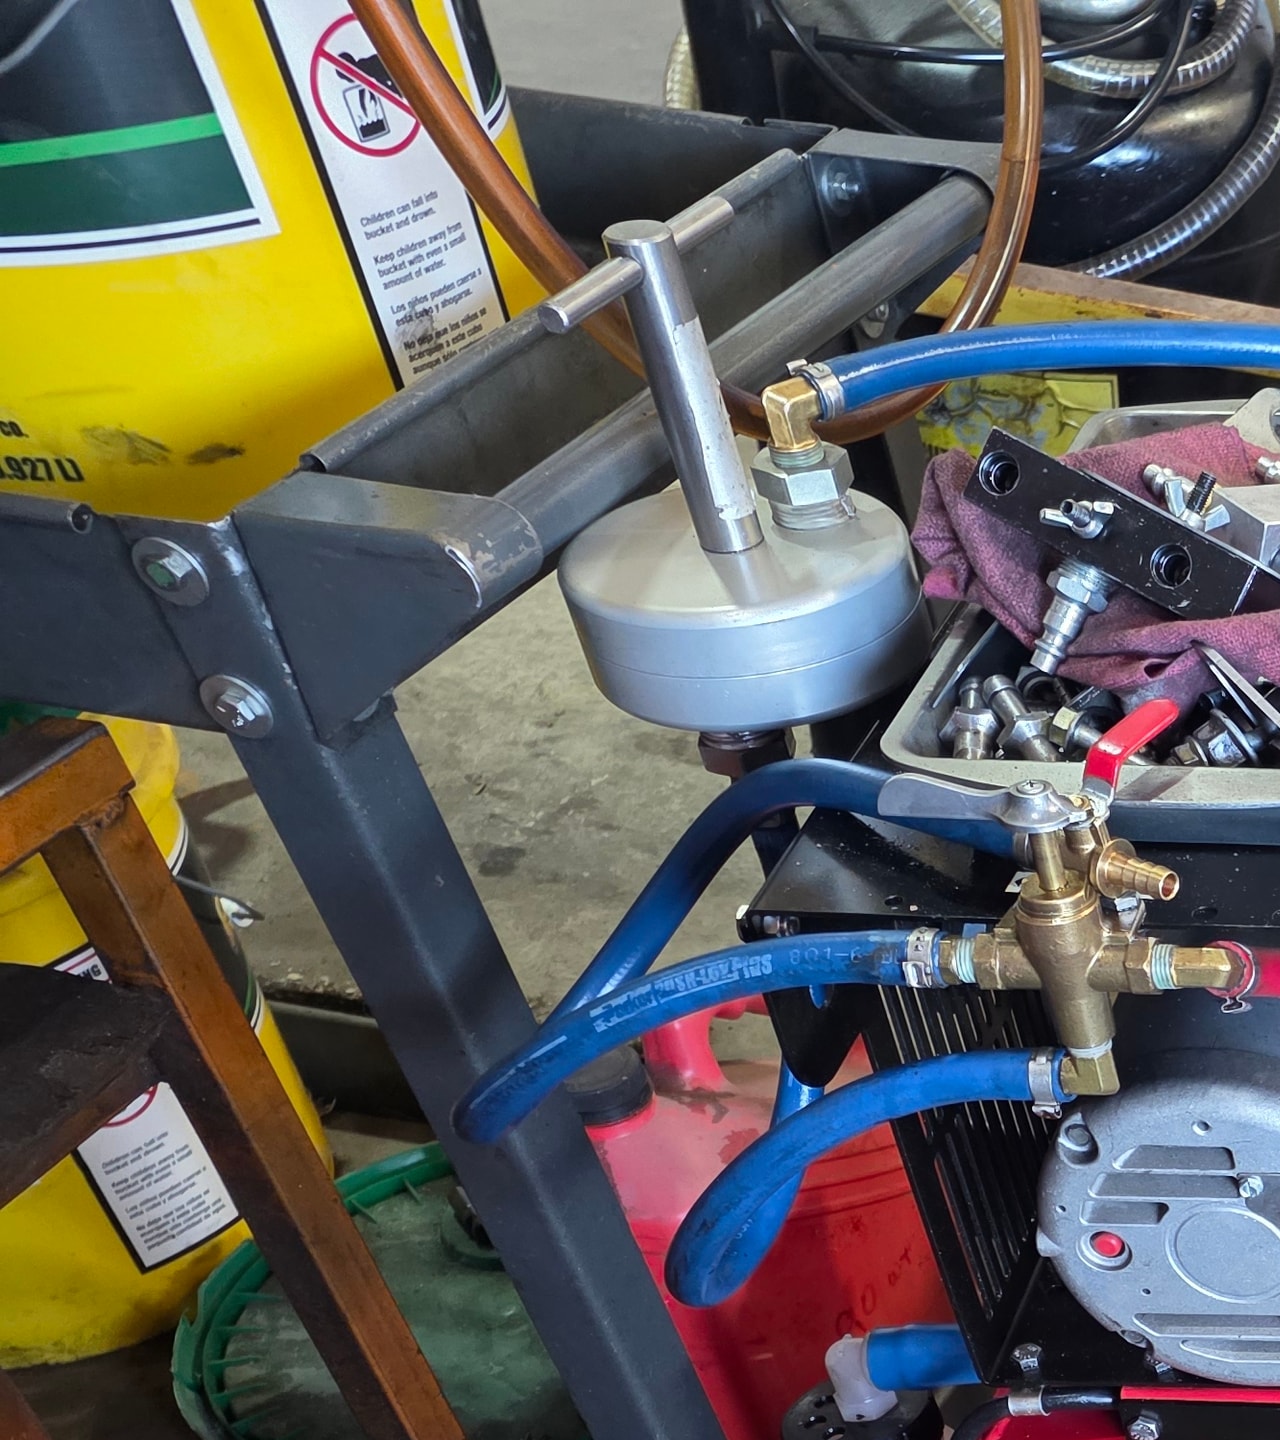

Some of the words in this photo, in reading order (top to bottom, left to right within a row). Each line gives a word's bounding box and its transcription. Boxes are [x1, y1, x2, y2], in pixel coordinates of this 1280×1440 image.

[360, 209, 396, 227] Children
[397, 202, 411, 215] can
[411, 195, 424, 208] fall
[424, 190, 439, 204] into
[364, 223, 394, 240] bucket
[396, 216, 410, 229] and
[373, 251, 395, 266] Keep
[397, 239, 427, 258] children
[429, 231, 447, 245] away
[447, 221, 462, 236] from
[378, 260, 407, 278] bucket
[408, 252, 425, 267] with
[426, 246, 443, 258] even
[450, 232, 466, 248] small
[382, 272, 414, 290] amount
[391, 303, 406, 315] Los
[430, 282, 456, 300] pueden
[403, 338, 415, 351] No
[0, 456, 55, 481] .927
